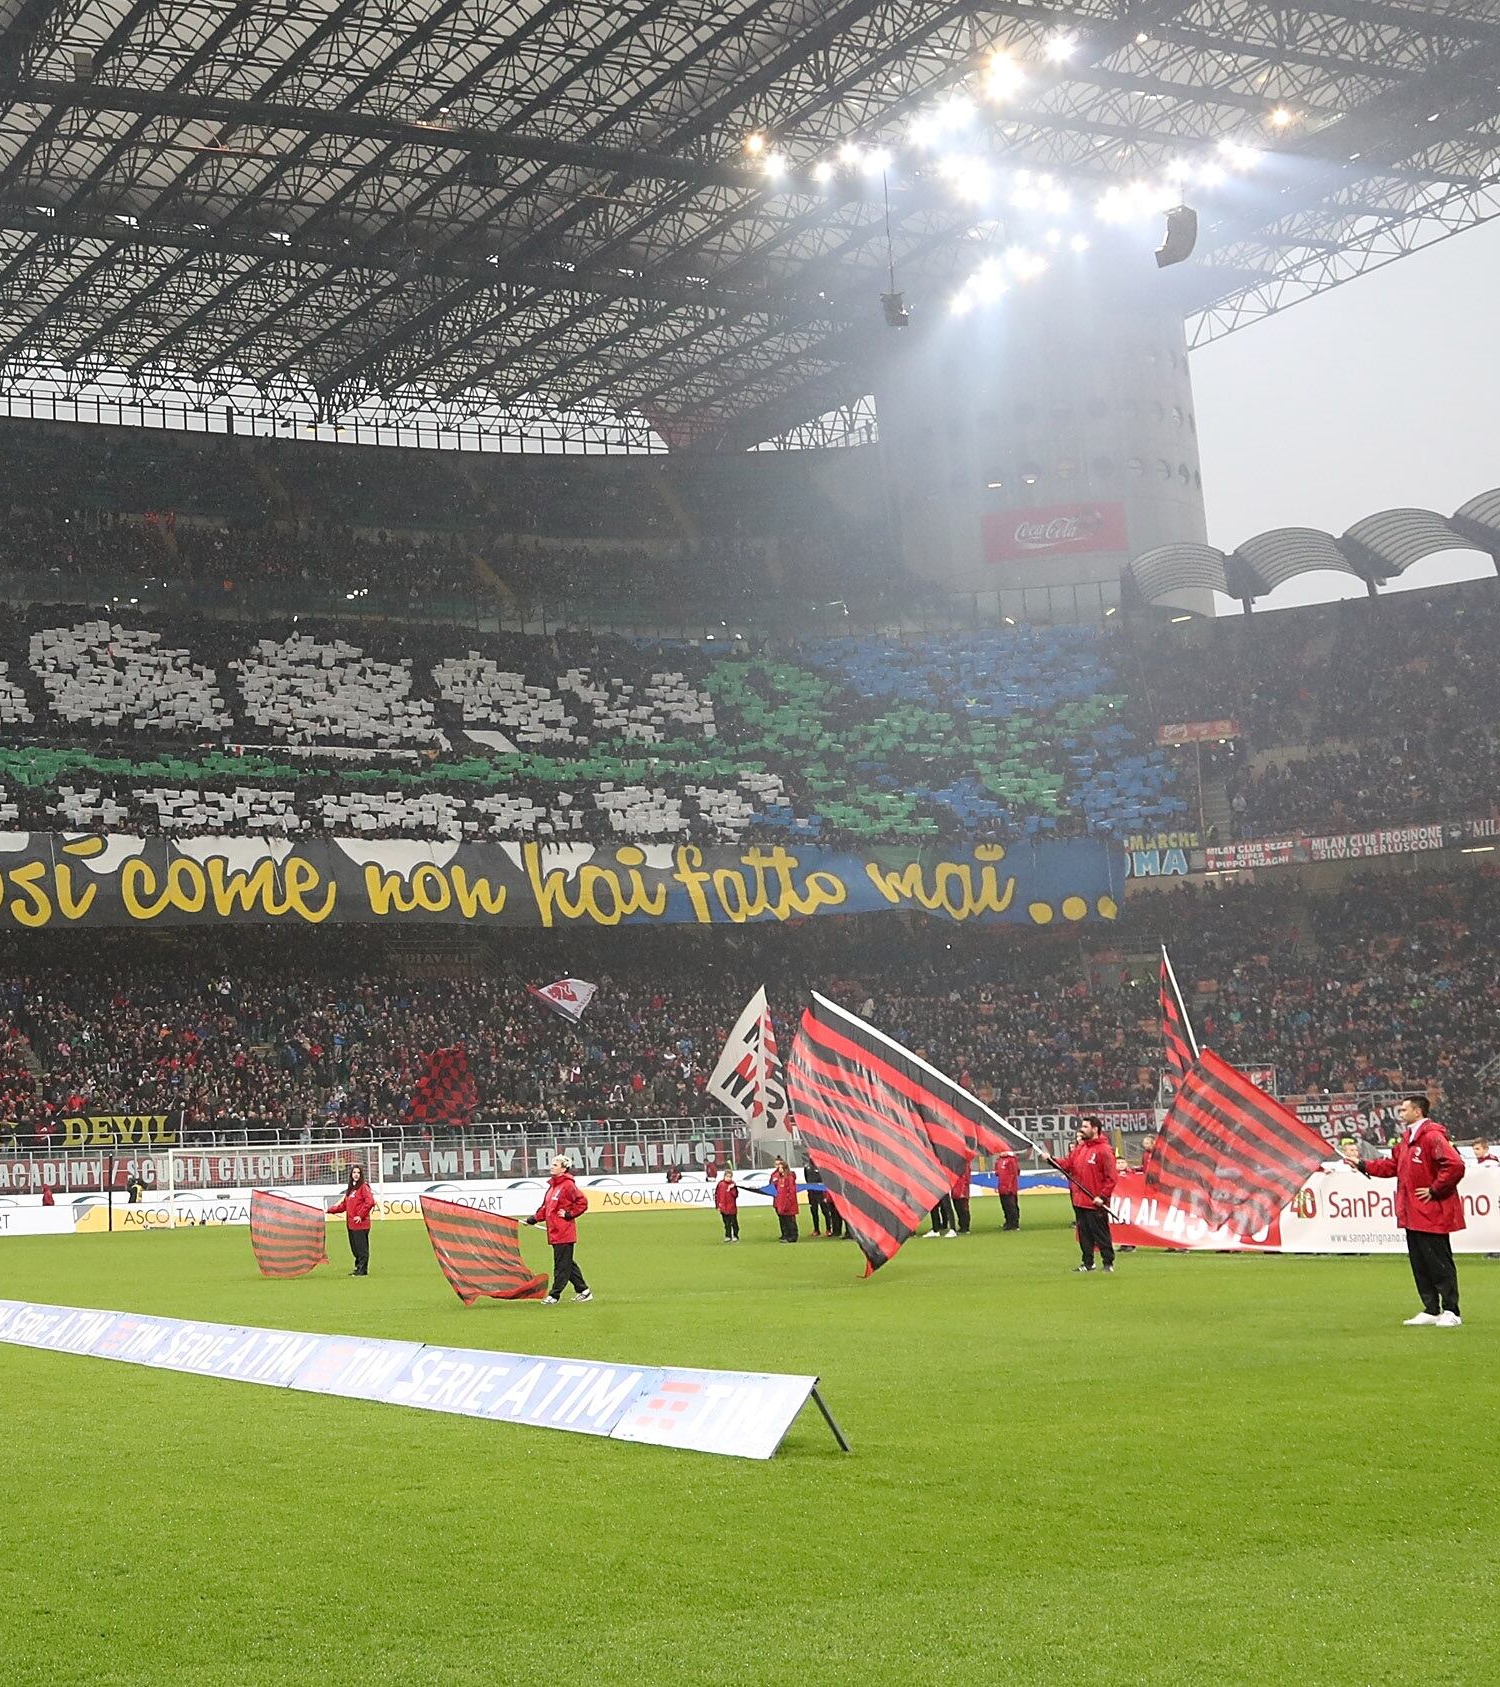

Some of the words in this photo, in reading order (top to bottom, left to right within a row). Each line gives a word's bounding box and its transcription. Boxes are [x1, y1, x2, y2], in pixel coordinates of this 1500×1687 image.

[1130, 832, 1199, 850] MARCHE
[1206, 846, 1236, 856] MILAN
[1237, 844, 1263, 854] CLUB
[1312, 837, 1346, 851] MILAN
[1350, 833, 1377, 848] CLUB
[1380, 826, 1442, 844] FROSINONE
[1320, 848, 1361, 860] SILVIO
[1365, 837, 1444, 856] BERLUSCONI
[1216, 859, 1246, 869] PIPPO
[1248, 856, 1290, 868] INZAGHI
[1236, 852, 1265, 861] SUPER
[122, 856, 337, 921] come
[366, 862, 506, 915] non
[522, 840, 666, 927] hai
[674, 844, 845, 924] fatto
[63, 1115, 177, 1147] DEVIL
[1090, 1112, 1147, 1132] EREGNO
[127, 1157, 212, 1184] SCUOLA
[218, 1155, 294, 1180] CALCIO
[383, 1149, 516, 1175] FAMILY
[536, 1145, 603, 1170] DAY
[623, 1142, 715, 1168] AIMC
[371, 1199, 421, 1215] ASCOL
[444, 1196, 503, 1211] OZART
[602, 1190, 666, 1206] ASCOLTA
[670, 1188, 716, 1203] MOZA
[123, 1208, 196, 1225] ASCOTA
[201, 1206, 250, 1221] MOZA
[1134, 1197, 1160, 1227] AL
[1, 1305, 50, 1344] SERIE
[60, 1311, 116, 1352] TIM
[126, 1322, 165, 1357] TIM
[155, 1324, 237, 1370] SERIE
[242, 1335, 321, 1380] TIM
[336, 1347, 404, 1387] TIM
[389, 1351, 506, 1411] SERIE
[532, 1365, 642, 1428] TIM
